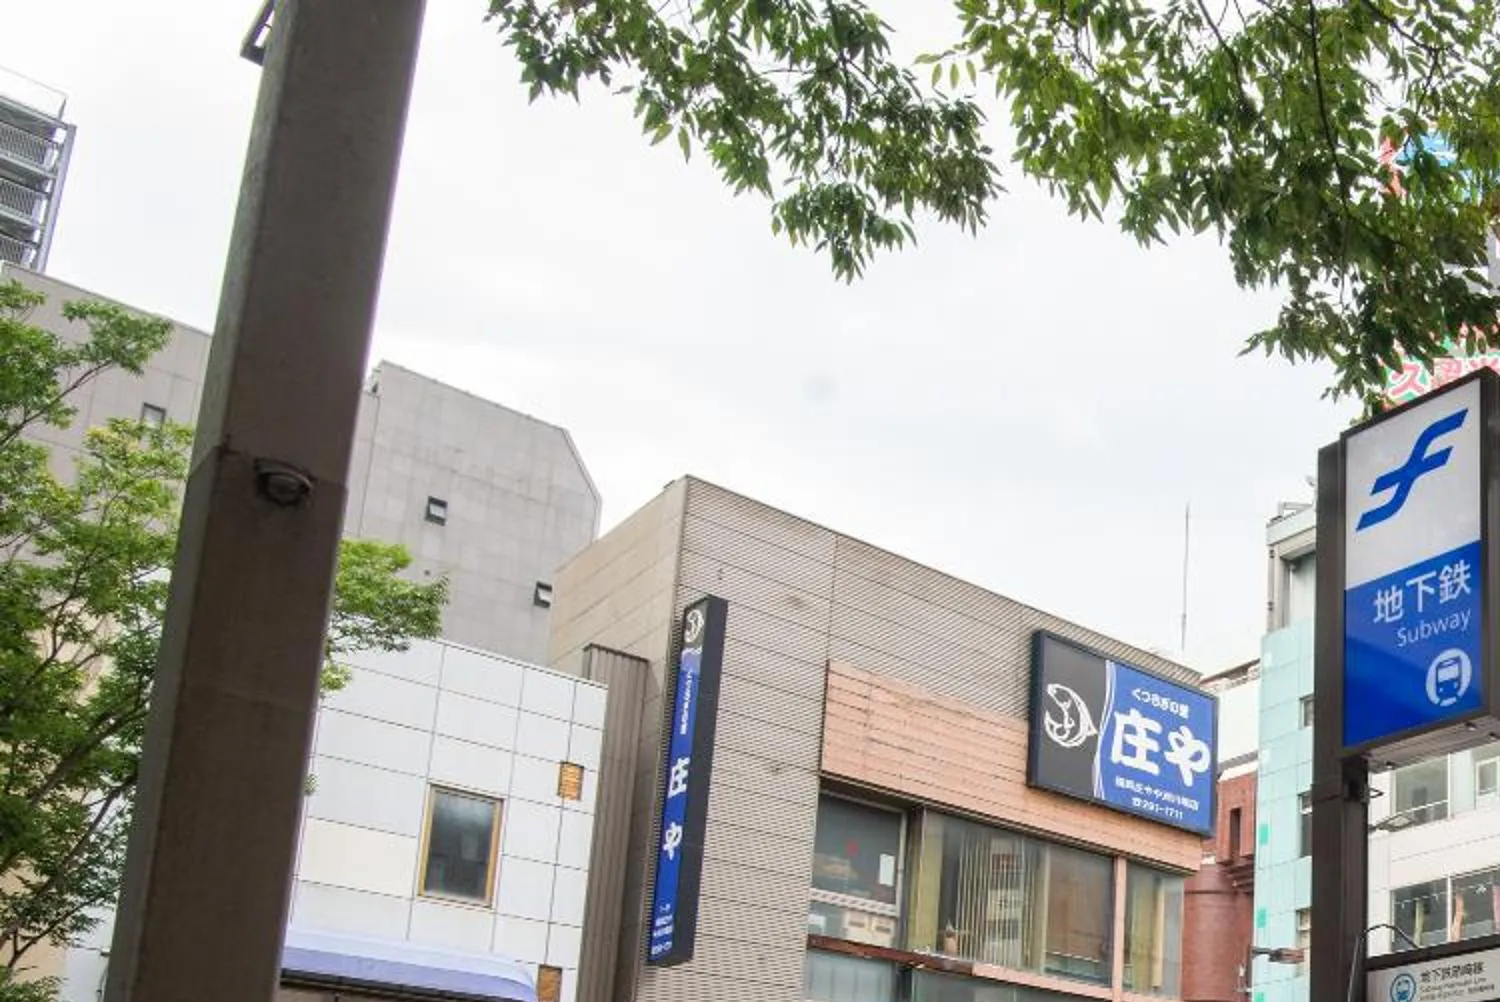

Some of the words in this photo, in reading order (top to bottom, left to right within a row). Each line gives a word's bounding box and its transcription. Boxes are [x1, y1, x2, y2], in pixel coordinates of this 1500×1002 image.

[1373, 559, 1471, 624] 地下鉄
[1397, 608, 1471, 647] Subway
[1111, 708, 1211, 788] 庄や
[663, 757, 691, 862] 庄や
